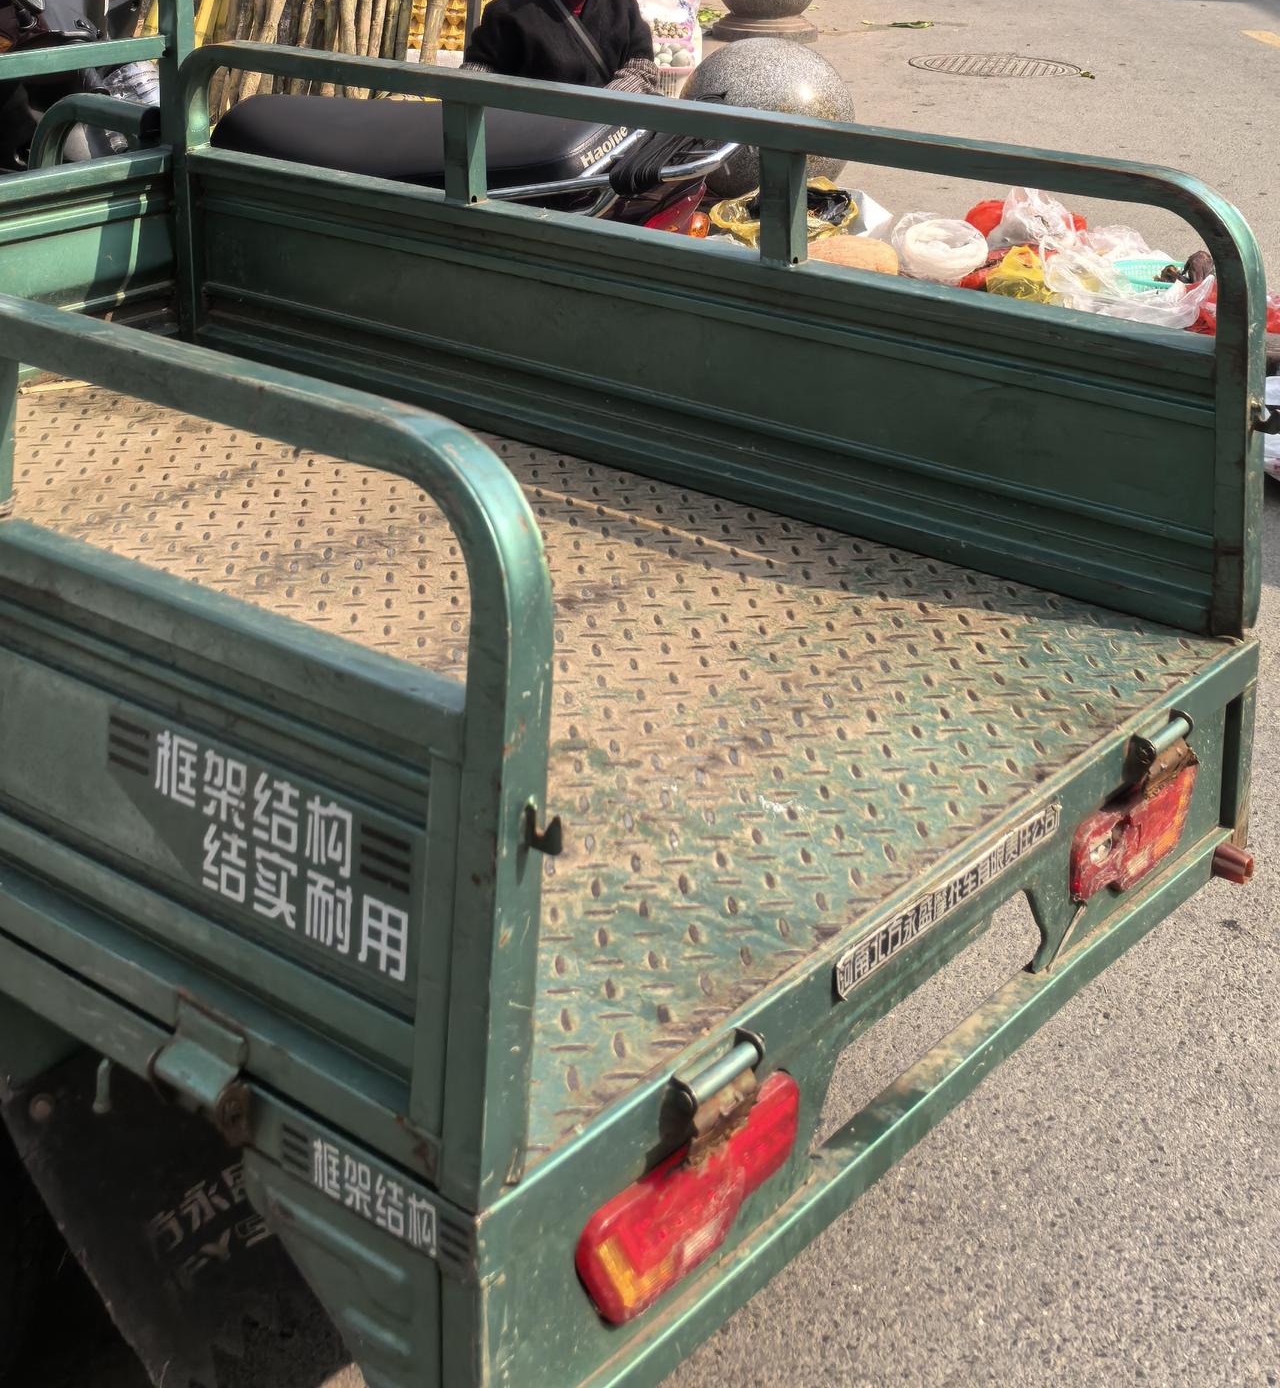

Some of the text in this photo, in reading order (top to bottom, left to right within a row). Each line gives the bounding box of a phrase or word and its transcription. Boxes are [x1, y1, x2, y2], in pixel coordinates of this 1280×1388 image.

[155, 730, 353, 879] 框架结构
[202, 823, 409, 981] 结实耐用
[313, 1138, 437, 1258] 框架结构
